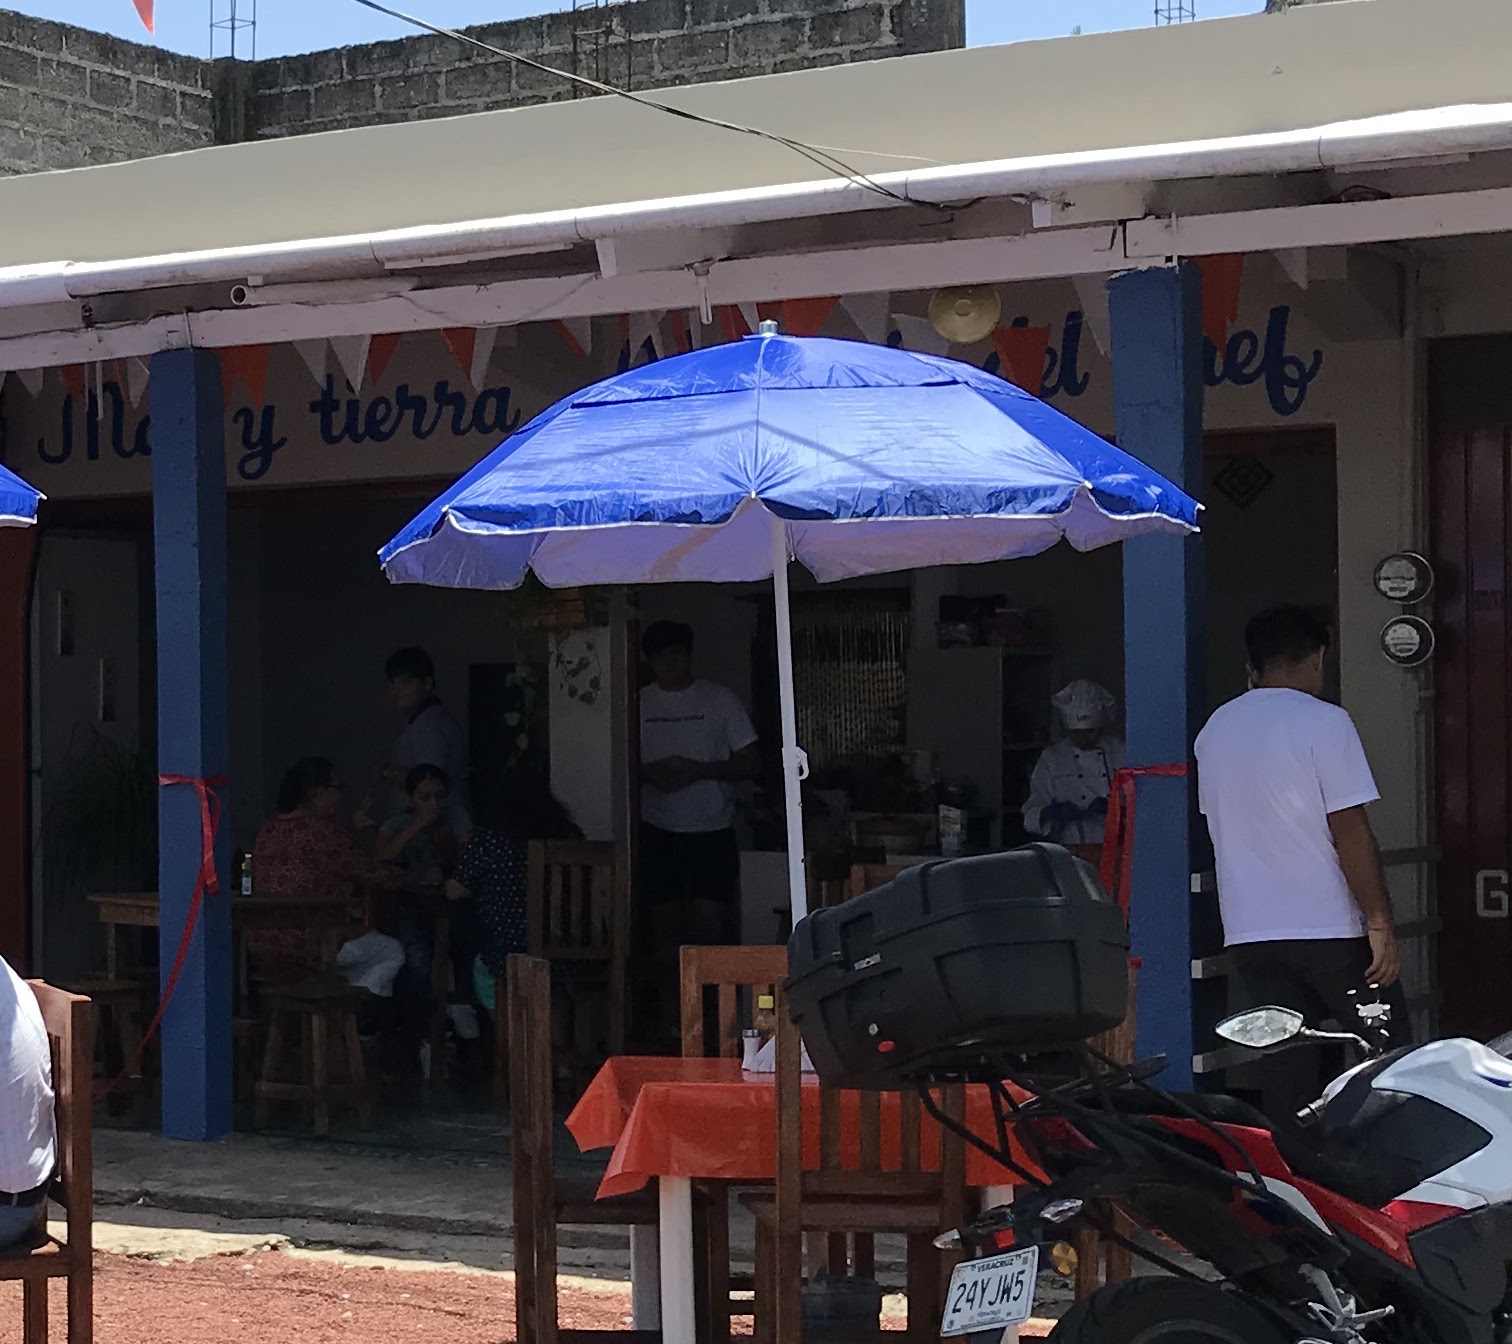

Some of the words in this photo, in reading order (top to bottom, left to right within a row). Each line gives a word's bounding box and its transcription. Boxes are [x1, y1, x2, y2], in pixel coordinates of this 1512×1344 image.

[232, 405, 288, 480] y
[309, 373, 521, 445] tierra
[952, 1269, 1026, 1314] 24YJW5
